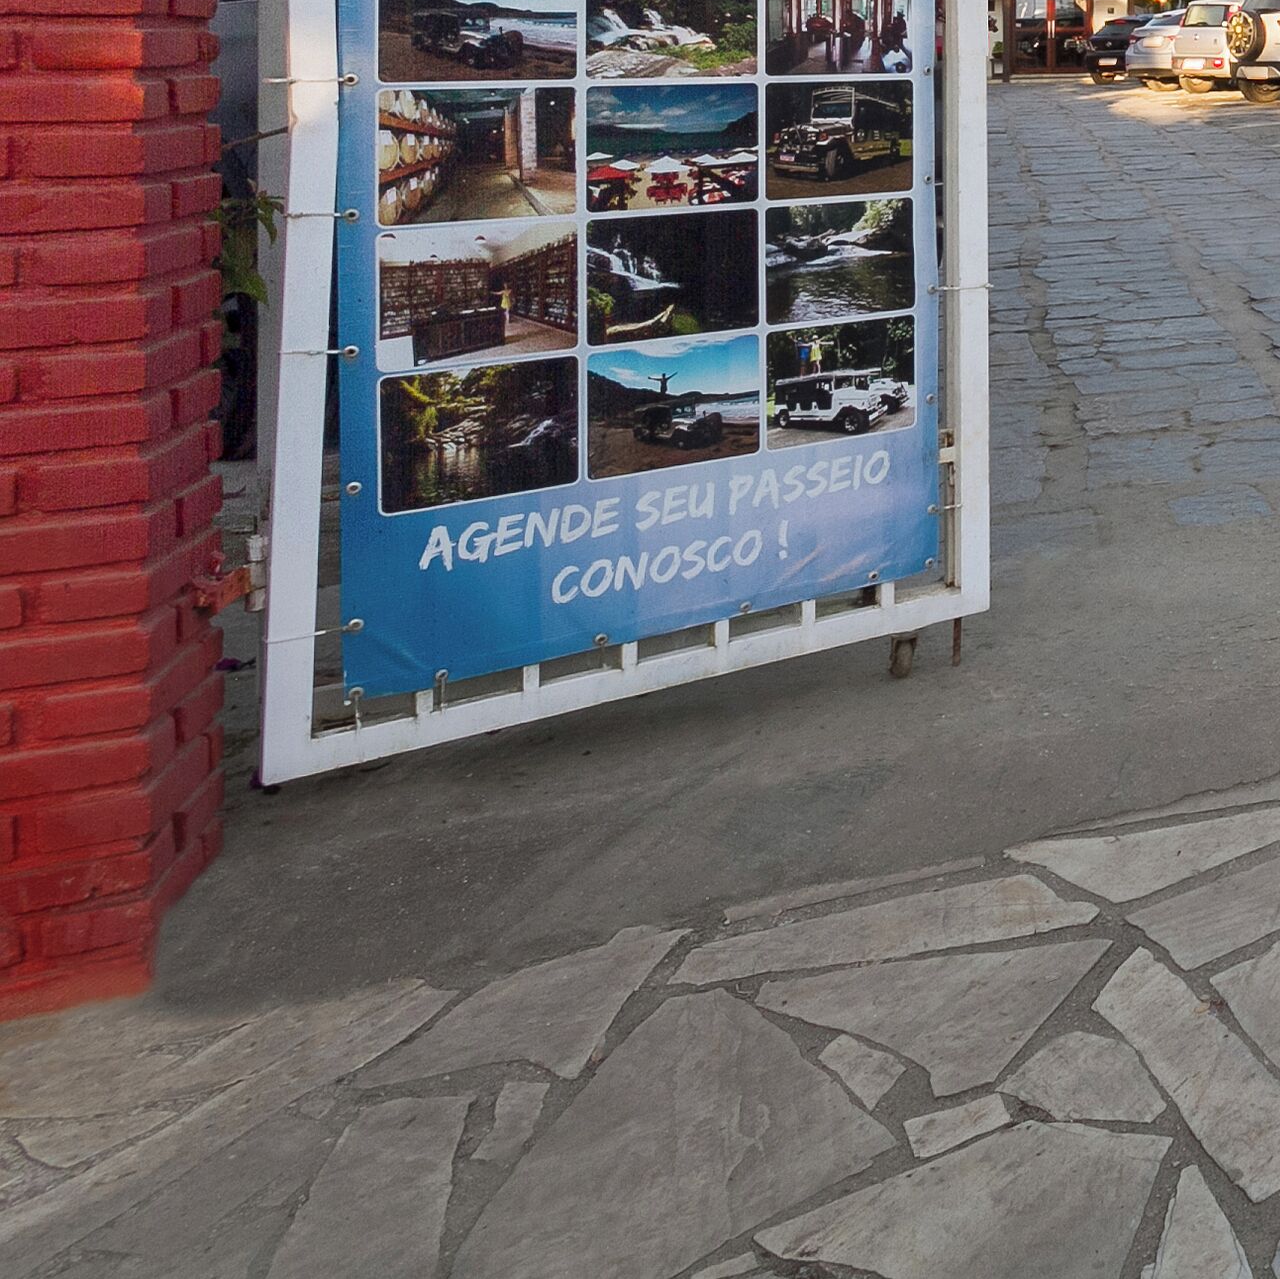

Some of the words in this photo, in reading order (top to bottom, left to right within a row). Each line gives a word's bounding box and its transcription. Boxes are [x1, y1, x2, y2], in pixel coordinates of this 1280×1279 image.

[419, 504, 620, 571] AGENDE
[634, 483, 716, 528] SEU
[728, 450, 891, 515] PASSEIO
[551, 529, 763, 604] CONOSCO
